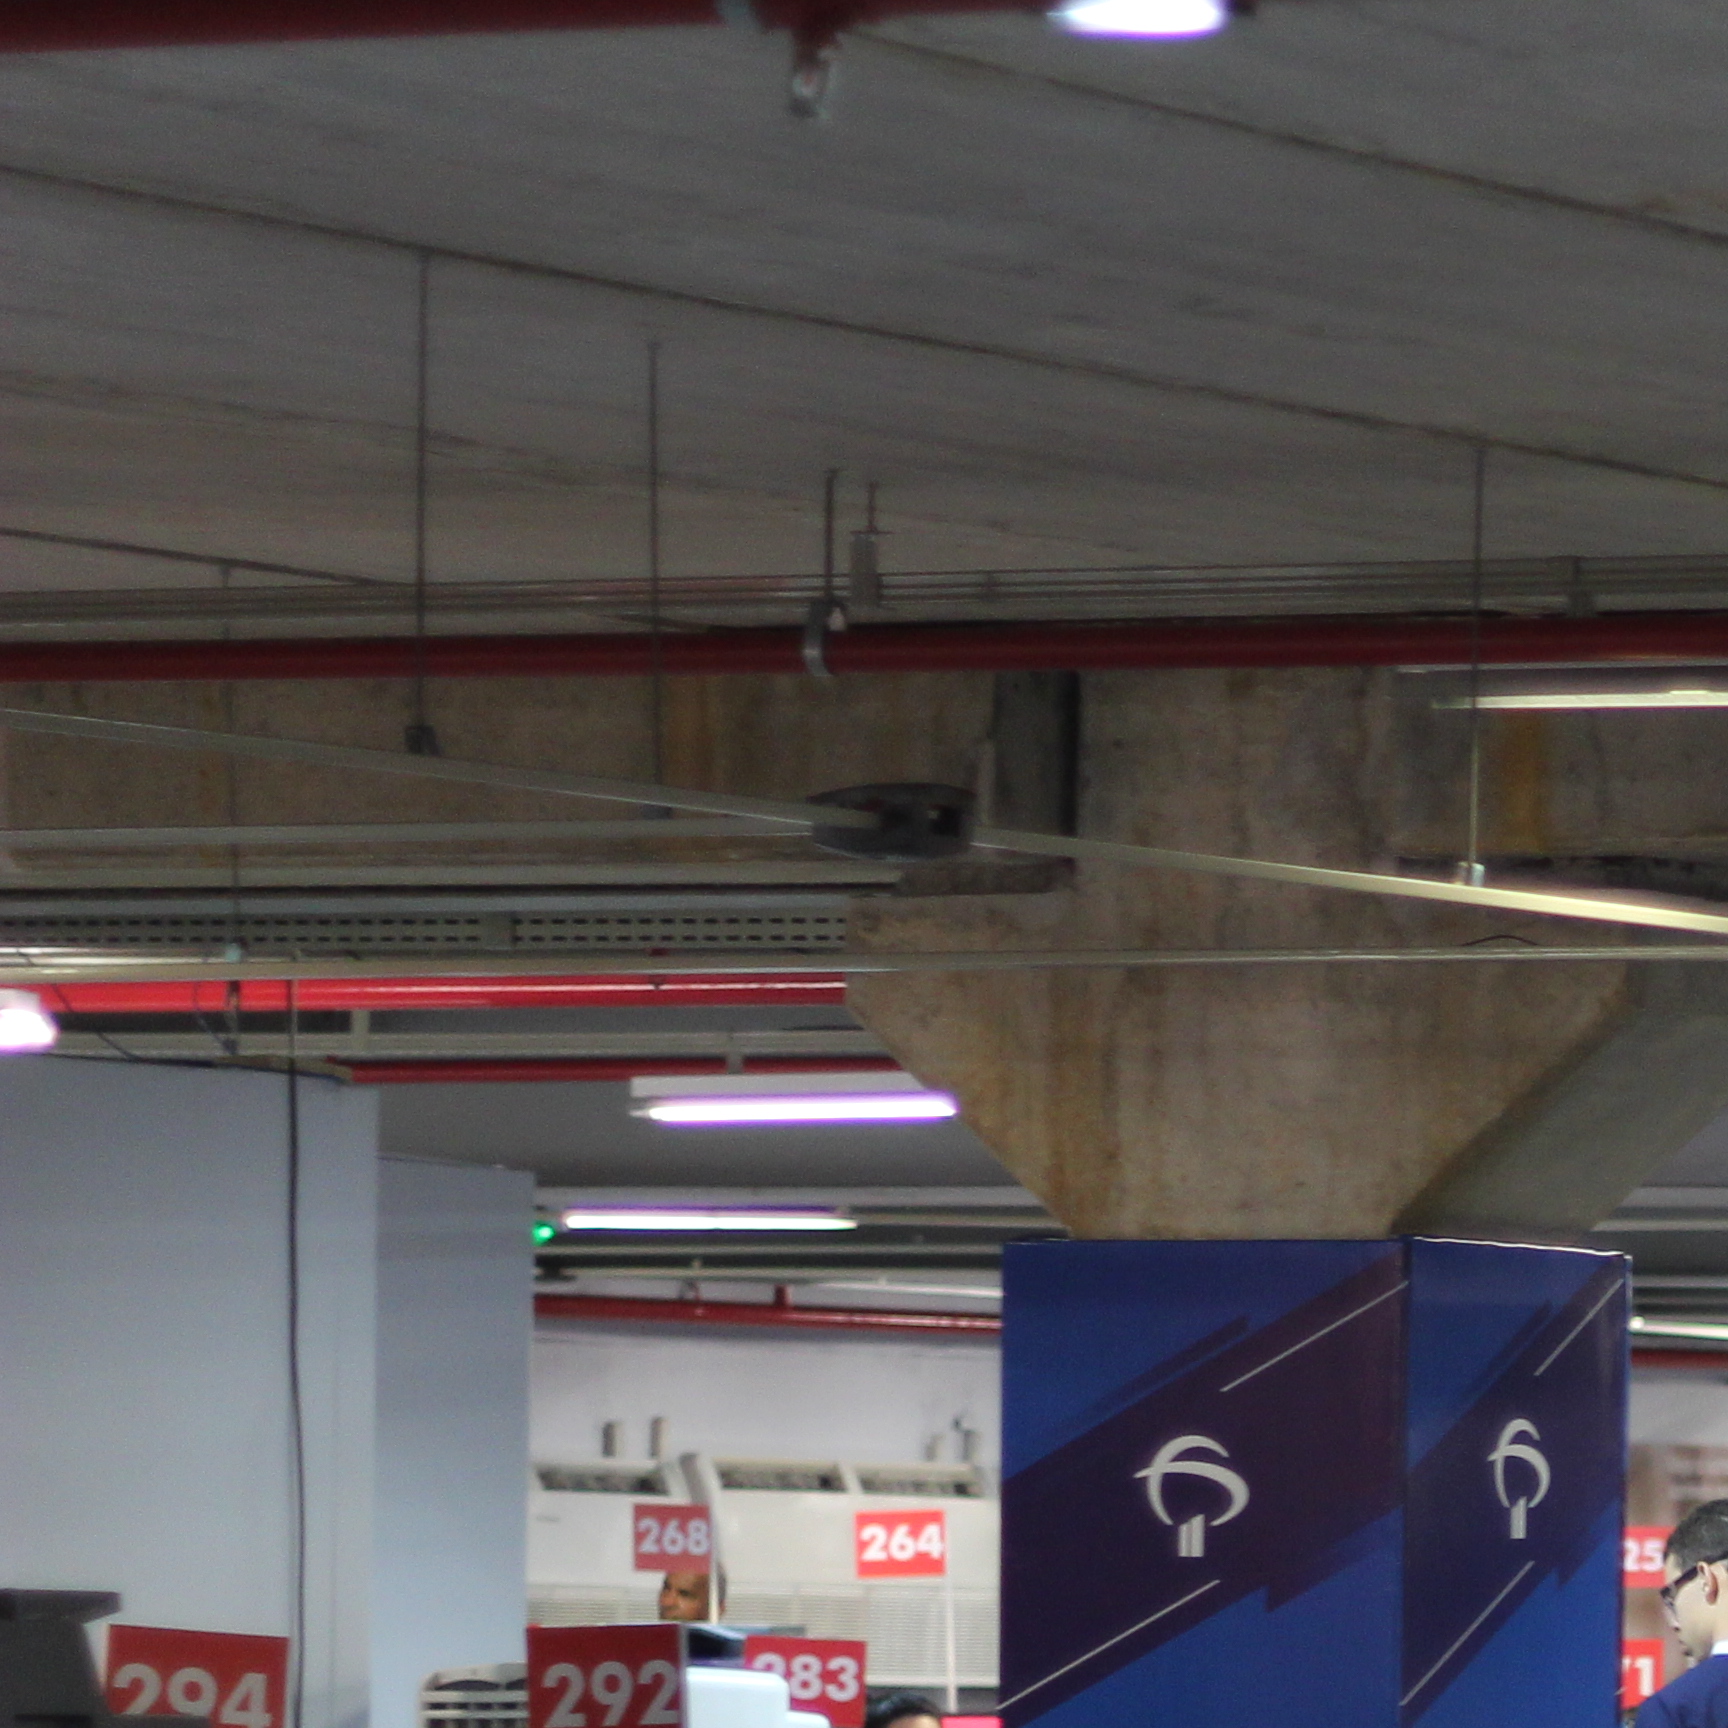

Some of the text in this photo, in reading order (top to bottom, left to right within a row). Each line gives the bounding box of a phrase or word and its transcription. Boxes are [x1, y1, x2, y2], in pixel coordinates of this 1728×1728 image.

[638, 1518, 709, 1556] 268
[860, 1523, 945, 1562] 264
[1624, 1540, 1664, 1572] 25
[541, 1660, 681, 1728] 292
